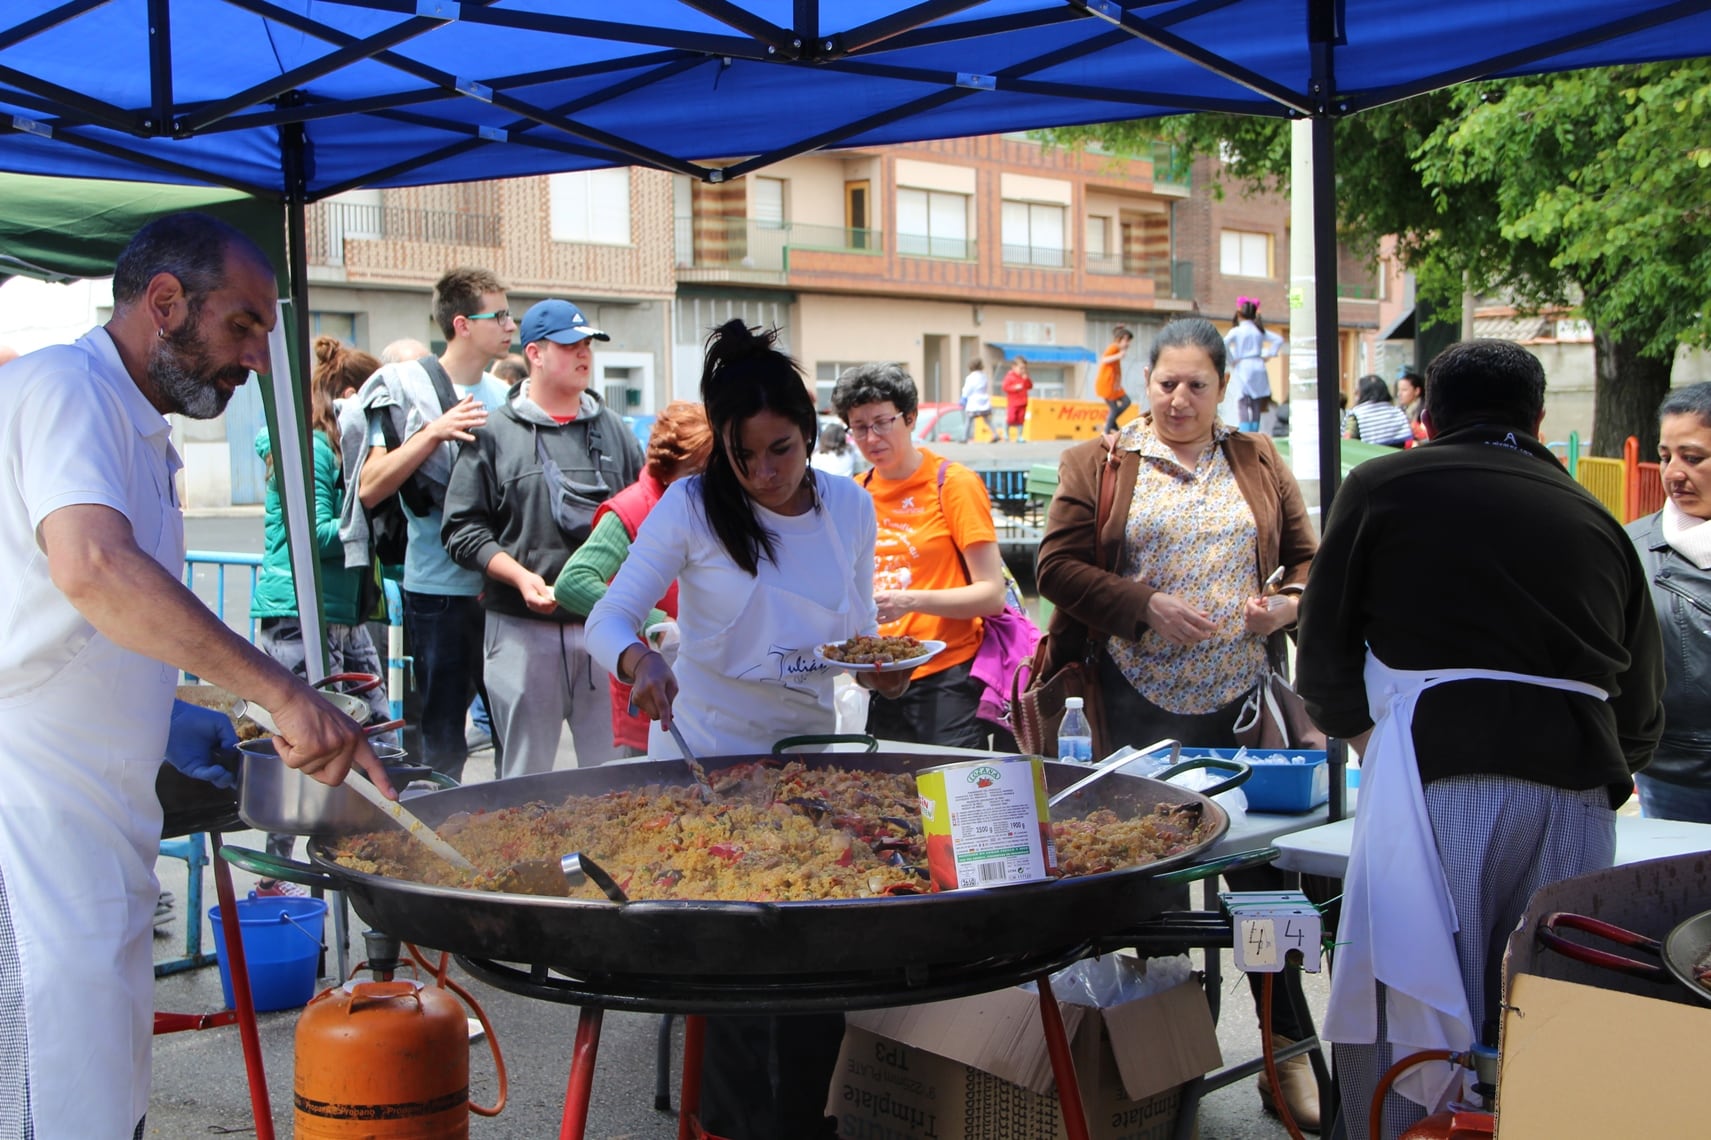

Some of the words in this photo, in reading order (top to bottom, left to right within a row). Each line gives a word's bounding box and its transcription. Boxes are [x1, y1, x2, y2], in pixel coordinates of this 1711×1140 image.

[1009, 821, 1022, 830] 1900
[1284, 919, 1305, 947] 4
[874, 1041, 910, 1071] TP3
[341, 1106, 376, 1117] Propano
[843, 1084, 939, 1138] Trimplate
[1111, 1087, 1180, 1128] rimplate
